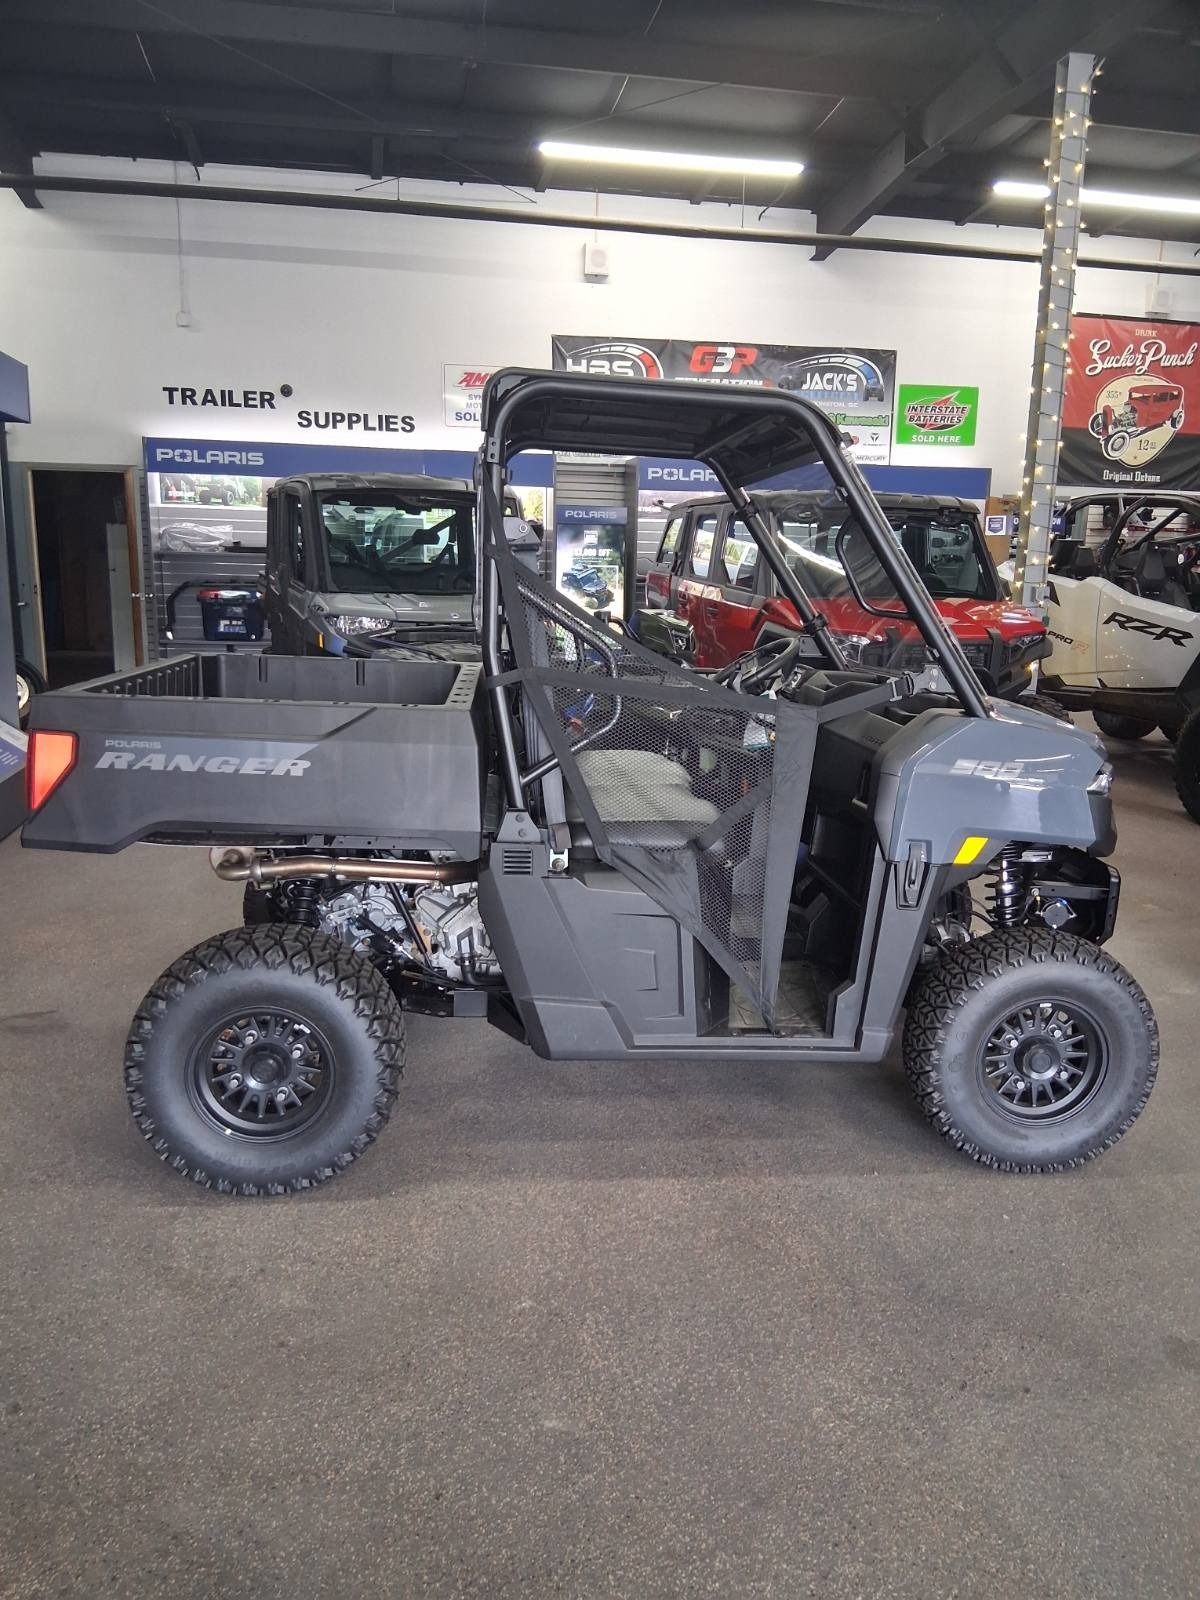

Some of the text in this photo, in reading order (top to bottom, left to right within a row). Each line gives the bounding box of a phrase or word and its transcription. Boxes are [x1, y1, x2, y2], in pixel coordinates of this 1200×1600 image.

[1086, 338, 1198, 375] Sucker Punch
[458, 372, 491, 387] AM
[801, 372, 858, 391] JACK'S
[162, 386, 277, 410] TRAILER
[455, 412, 481, 421] SOL
[907, 405, 967, 414] INTERSTATE
[297, 410, 415, 433] SUPPLIES
[908, 415, 962, 424] BATTERIES
[938, 435, 960, 443] HERE
[1137, 439, 1149, 450] 12
[156, 448, 265, 465] POLARIS
[1103, 469, 1161, 483] Original Octane
[565, 510, 617, 519] POLARIS
[1102, 611, 1194, 647] RZR
[1047, 630, 1074, 645] PRO
[105, 739, 161, 749] POLARIS
[95, 751, 312, 777] RANGER
